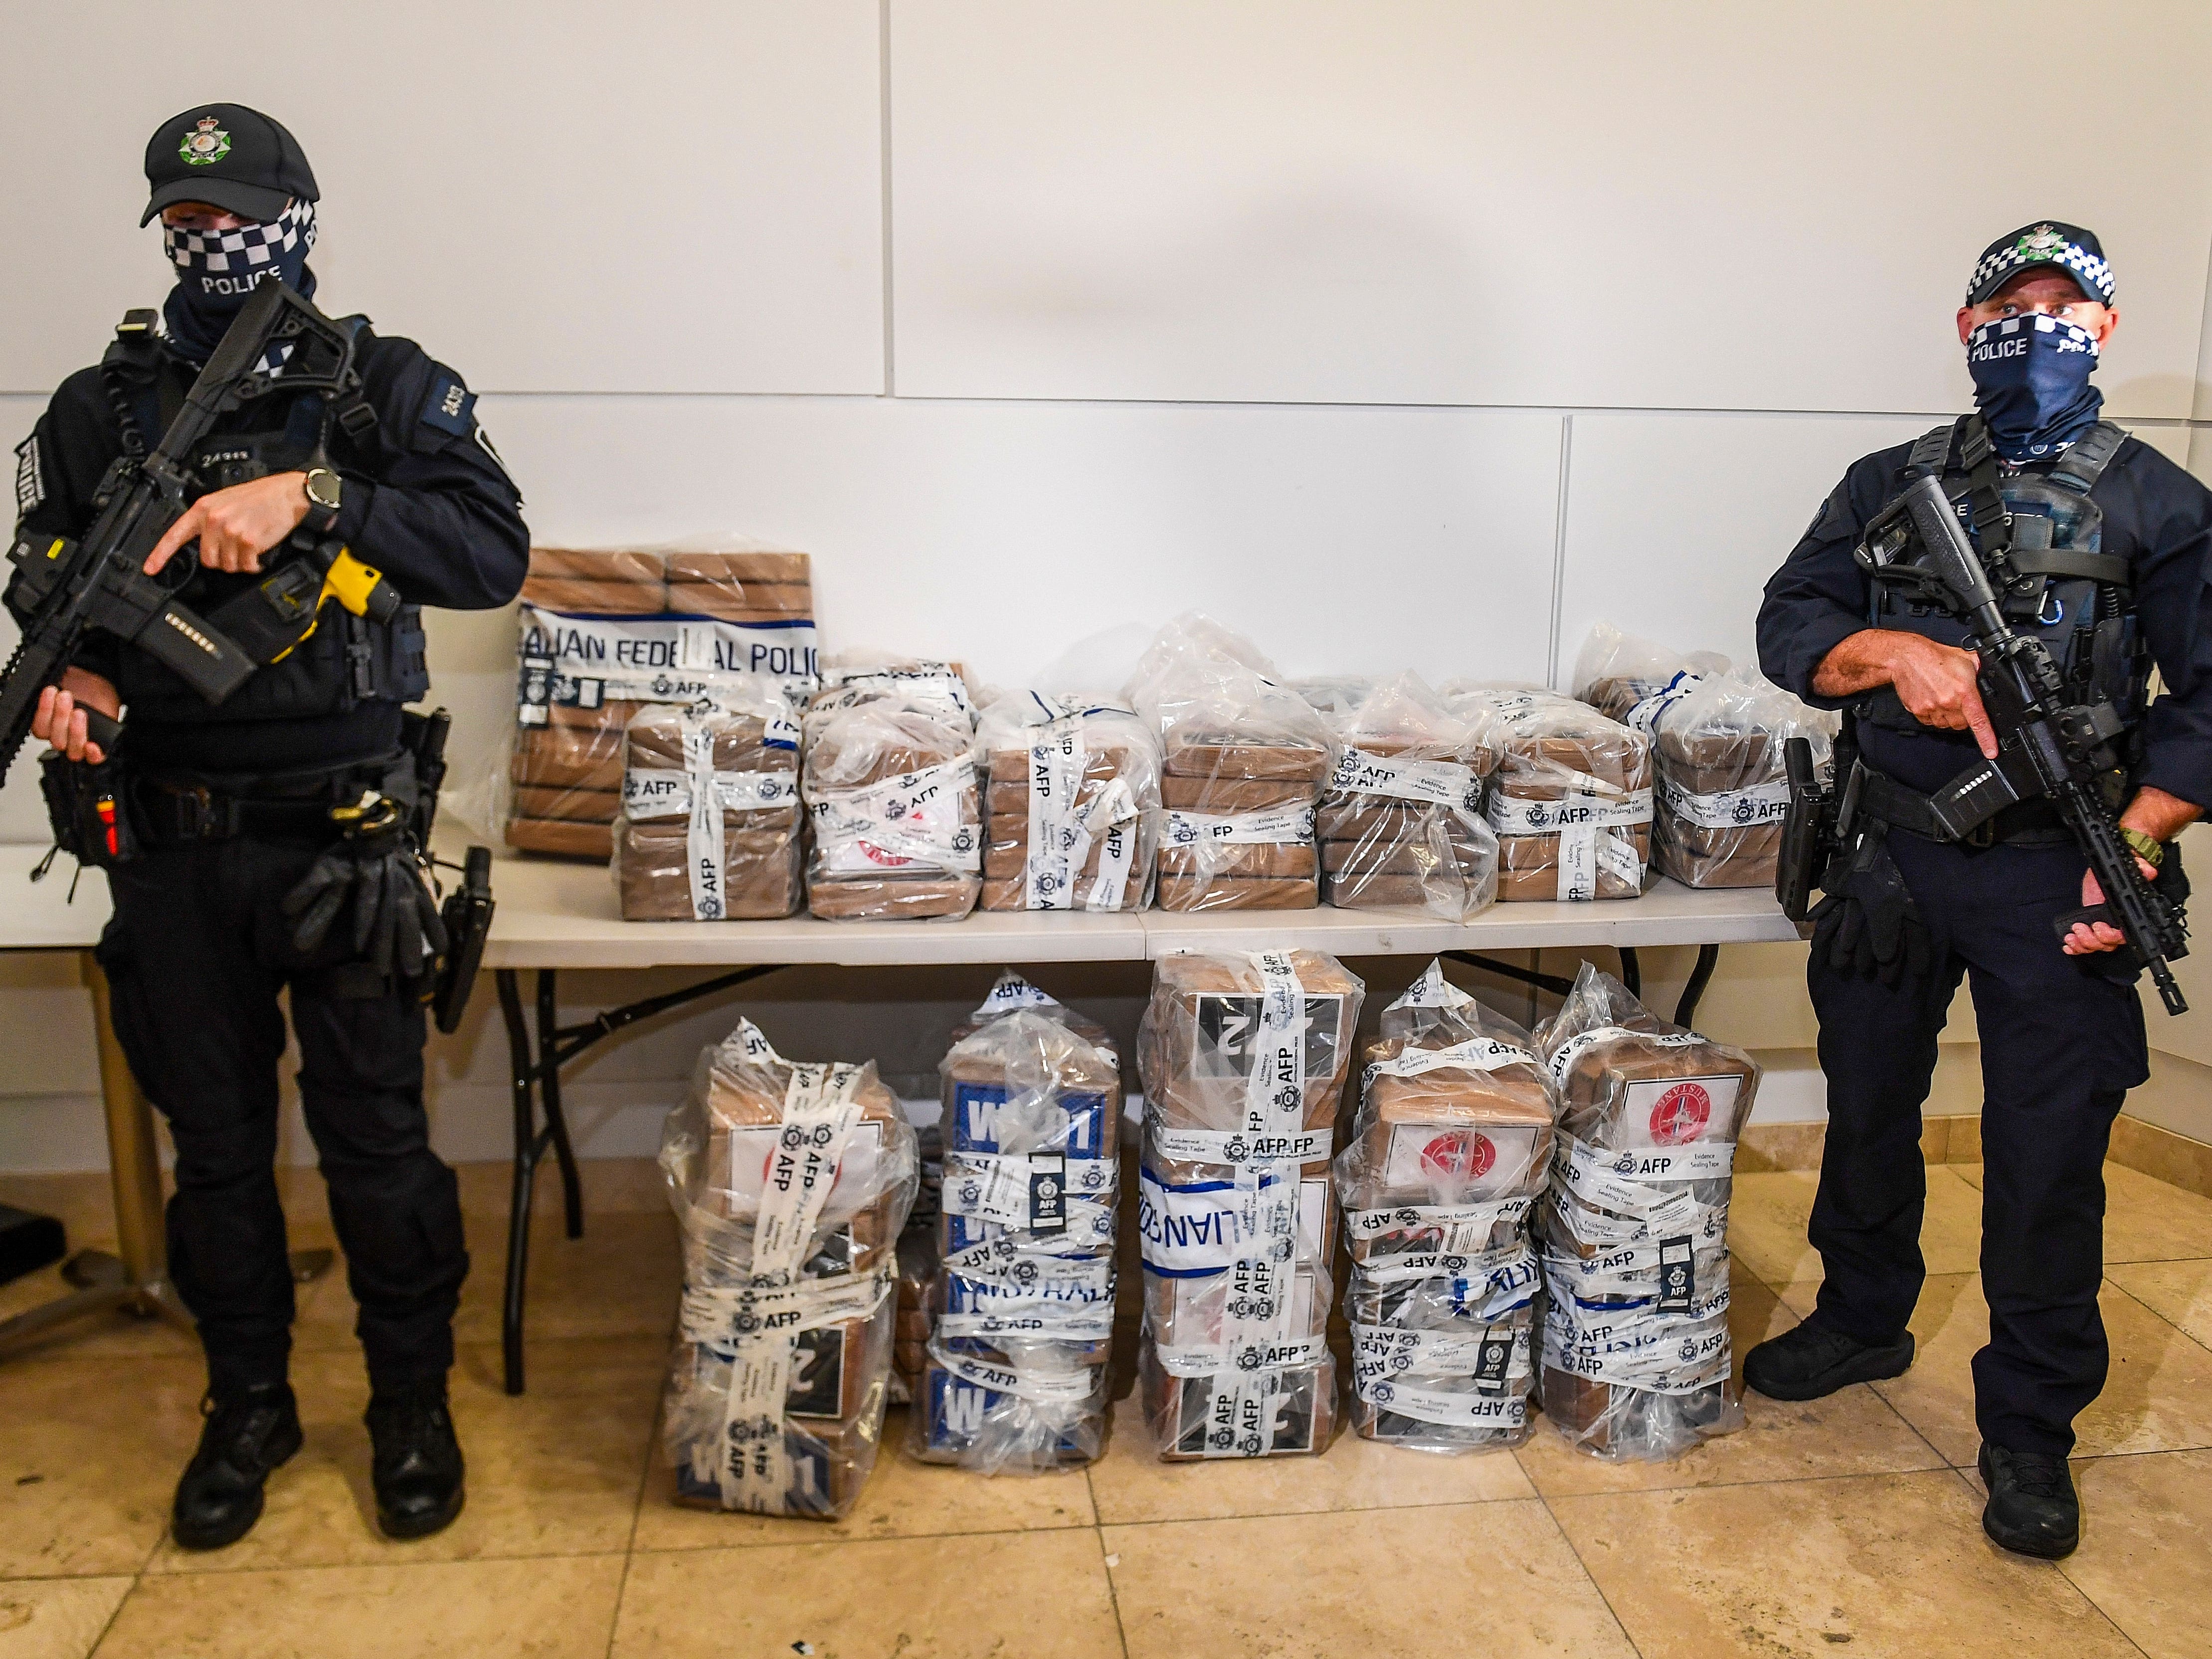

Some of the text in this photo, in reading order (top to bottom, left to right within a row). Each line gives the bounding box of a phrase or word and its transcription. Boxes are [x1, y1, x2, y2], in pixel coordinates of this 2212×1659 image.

[1971, 338, 2028, 363] POLICE
[617, 639, 740, 671] FEDEAL
[643, 781, 676, 796] AFP
[1036, 764, 1050, 797] AFP
[1420, 778, 1447, 790] Evidence
[1609, 805, 1645, 816] Sealing Tape
[1614, 799, 1640, 808] Evidence
[1757, 802, 1787, 818] AFP
[1258, 815, 1285, 824] Evidence
[1558, 807, 1590, 825] AFP
[1213, 825, 1233, 838] FP
[1107, 826, 1123, 859] AFP
[701, 857, 717, 893] AFP
[1568, 888, 1584, 900] FP
[996, 980, 1023, 998] AFP
[746, 1038, 767, 1056] AF
[1278, 1047, 1293, 1083] AFP
[1555, 1046, 1570, 1078] AFP
[1656, 1085, 1708, 1107] MUSTANG
[1248, 1110, 1264, 1132] FP
[1253, 1138, 1287, 1154] AFP
[774, 1155, 795, 1192] AFP
[803, 1151, 822, 1188] AFP
[1561, 1160, 1581, 1183] AFP
[1639, 1157, 1671, 1174] AFP
[1597, 1188, 1635, 1207] Sealing Tape
[1605, 1183, 1633, 1197] Evidence
[1362, 1213, 1390, 1229] AFP
[1584, 1220, 1612, 1231] Evidence
[1403, 1256, 1437, 1268] AFP
[1602, 1251, 1635, 1269] AFP
[1234, 1260, 1252, 1293] AFP
[1254, 1262, 1271, 1294] AFP
[1670, 1286, 1686, 1296] AFP
[1706, 1290, 1729, 1311] AFP
[764, 1311, 801, 1328] AFP
[1581, 1325, 1613, 1343] AFP
[1701, 1333, 1723, 1354] AFP
[1265, 1347, 1298, 1362] AFP
[1577, 1356, 1603, 1375] AFP
[982, 1370, 1017, 1386] AFP
[1215, 1394, 1233, 1424] AFP
[1242, 1398, 1260, 1431] AFP
[1472, 1402, 1504, 1417] AFP
